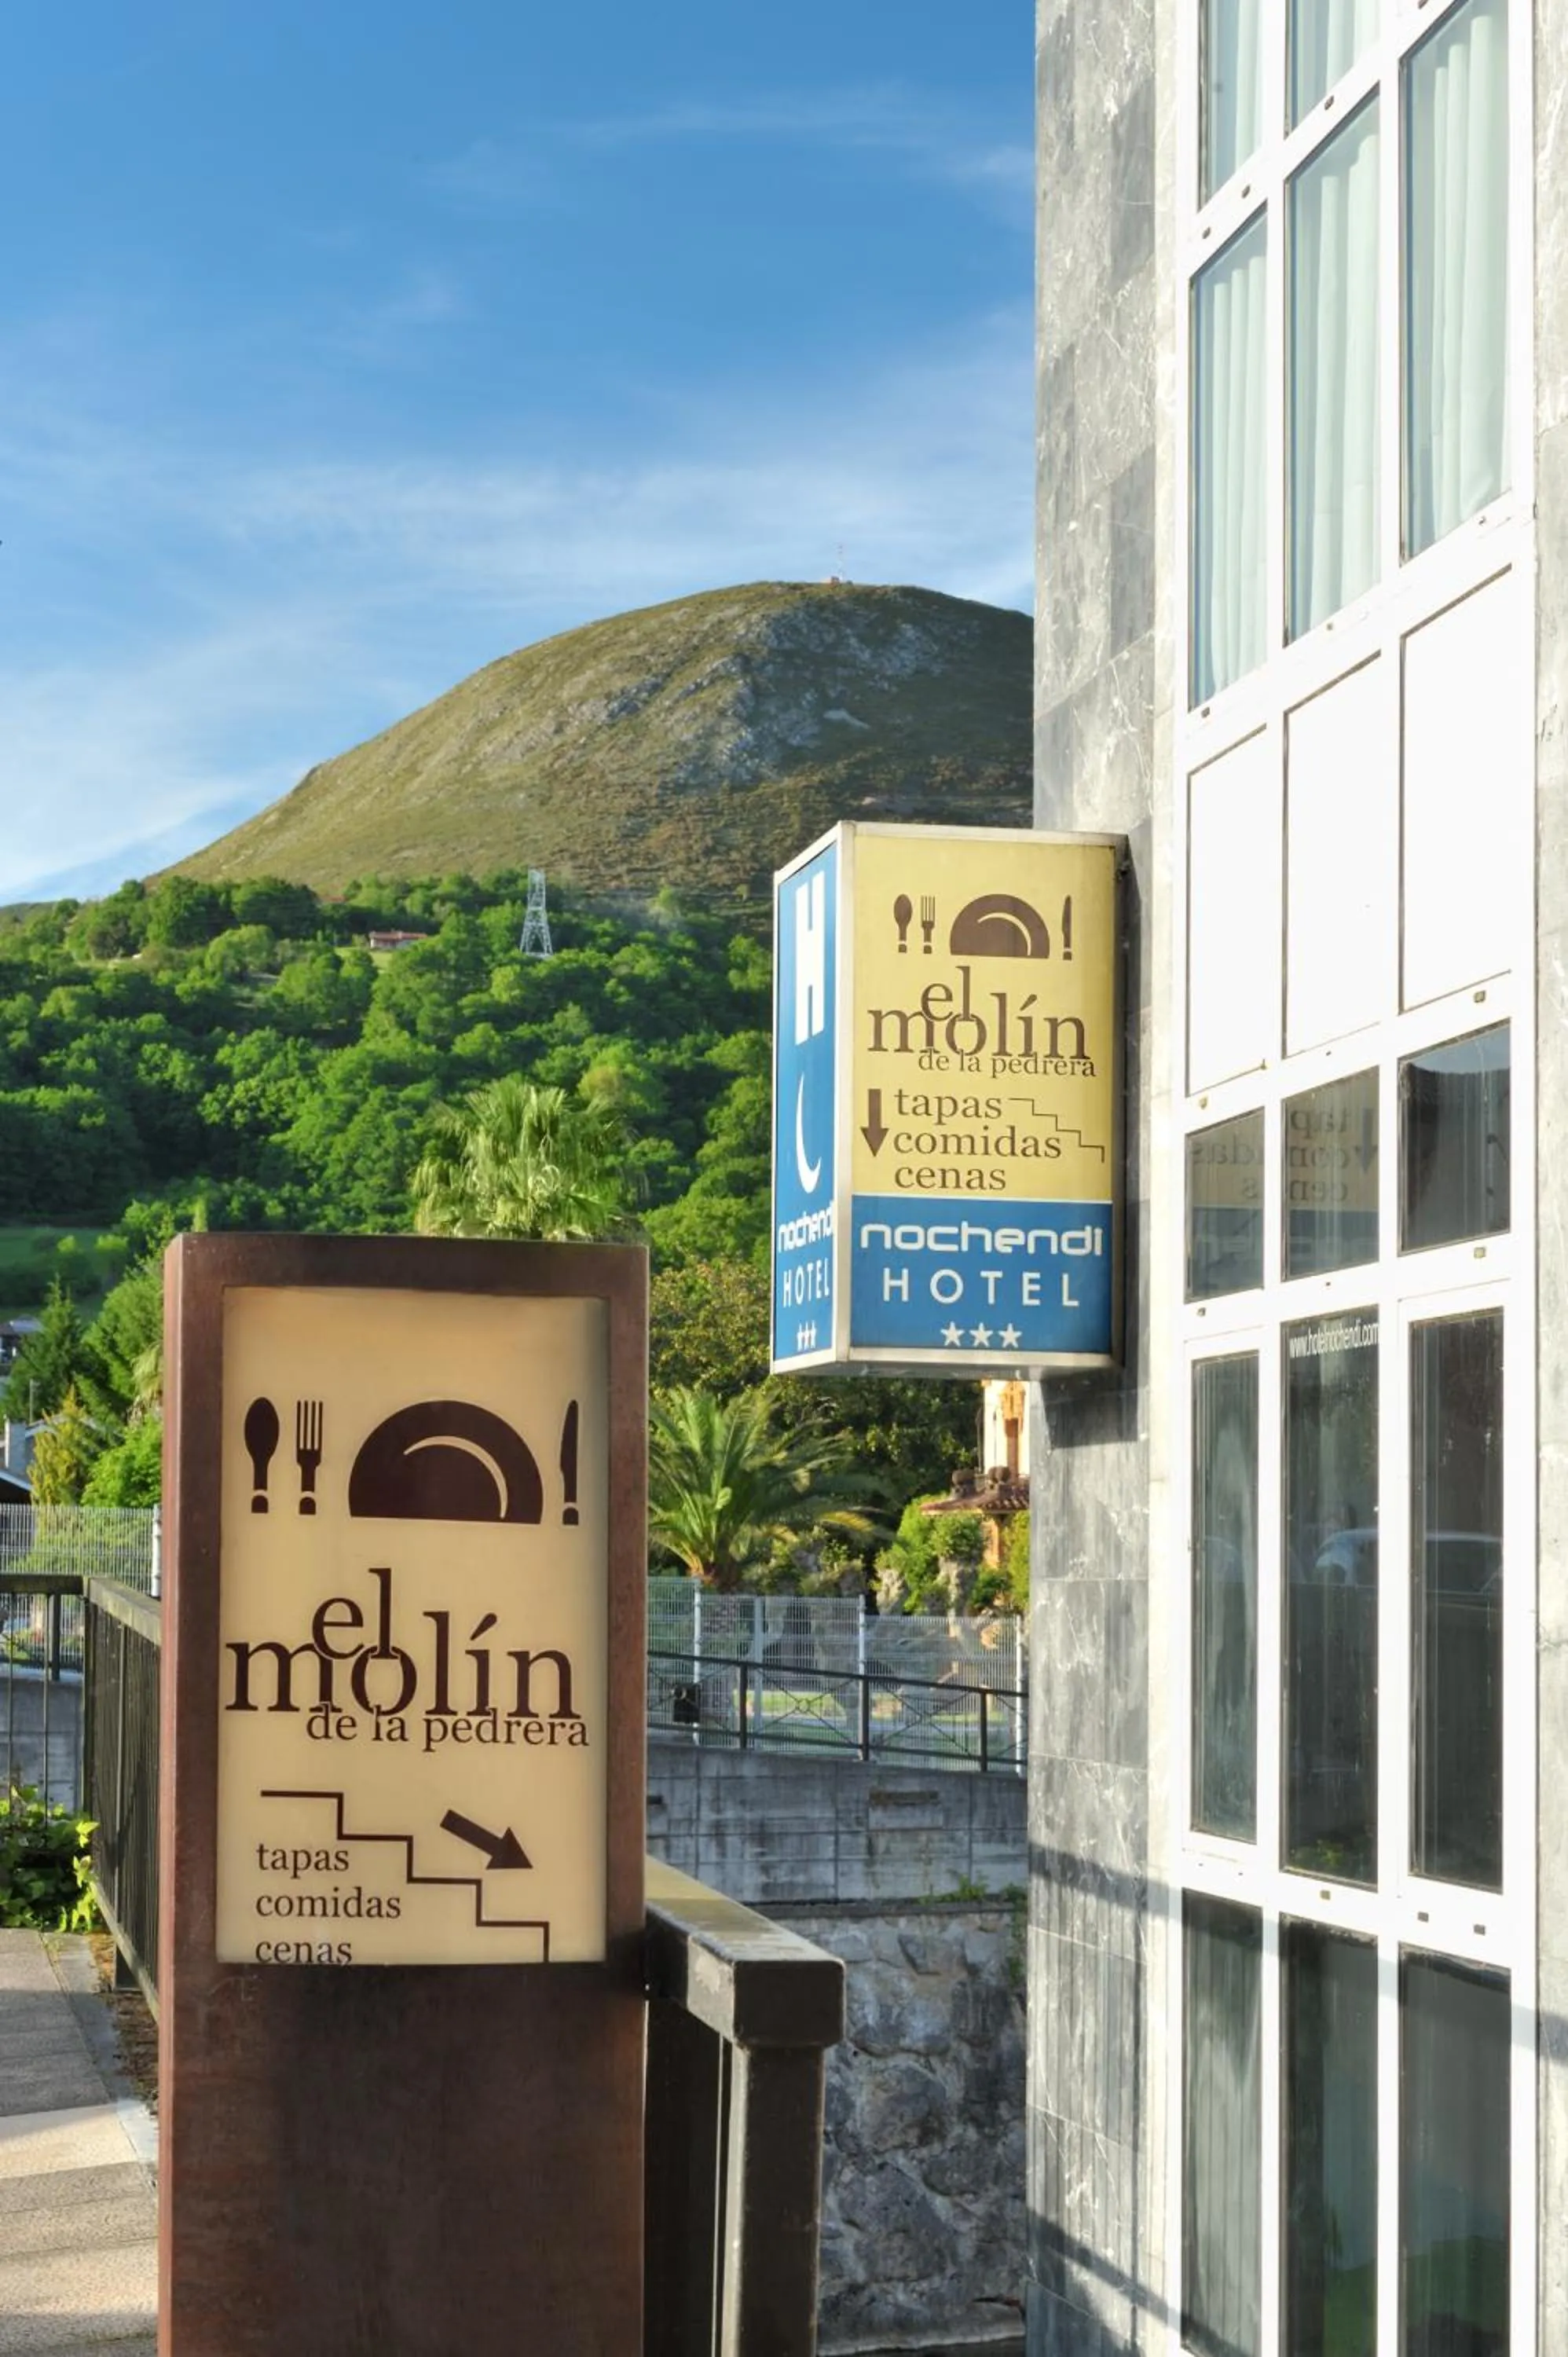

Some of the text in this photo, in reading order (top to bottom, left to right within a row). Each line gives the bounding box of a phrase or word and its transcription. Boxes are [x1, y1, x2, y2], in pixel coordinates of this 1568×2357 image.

[796, 870, 825, 1046] H
[921, 966, 979, 1021] el
[867, 992, 1091, 1060] molín
[918, 1049, 1097, 1080] de la pedrera
[894, 1088, 1002, 1126] tapas
[893, 1124, 1061, 1159] comidas
[894, 1166, 1006, 1191] cenas
[779, 1200, 834, 1253] nochend
[860, 1220, 1103, 1256] nochendi
[783, 1257, 830, 1308] HOTEL
[883, 1266, 1079, 1307] HOTEL
[312, 1567, 398, 1659] el
[225, 1611, 581, 1719] molín
[306, 1702, 589, 1752] de la pedrera
[256, 1843, 350, 1879] tapas
[255, 1886, 401, 1919] comidas
[255, 1941, 352, 1965] cenas
